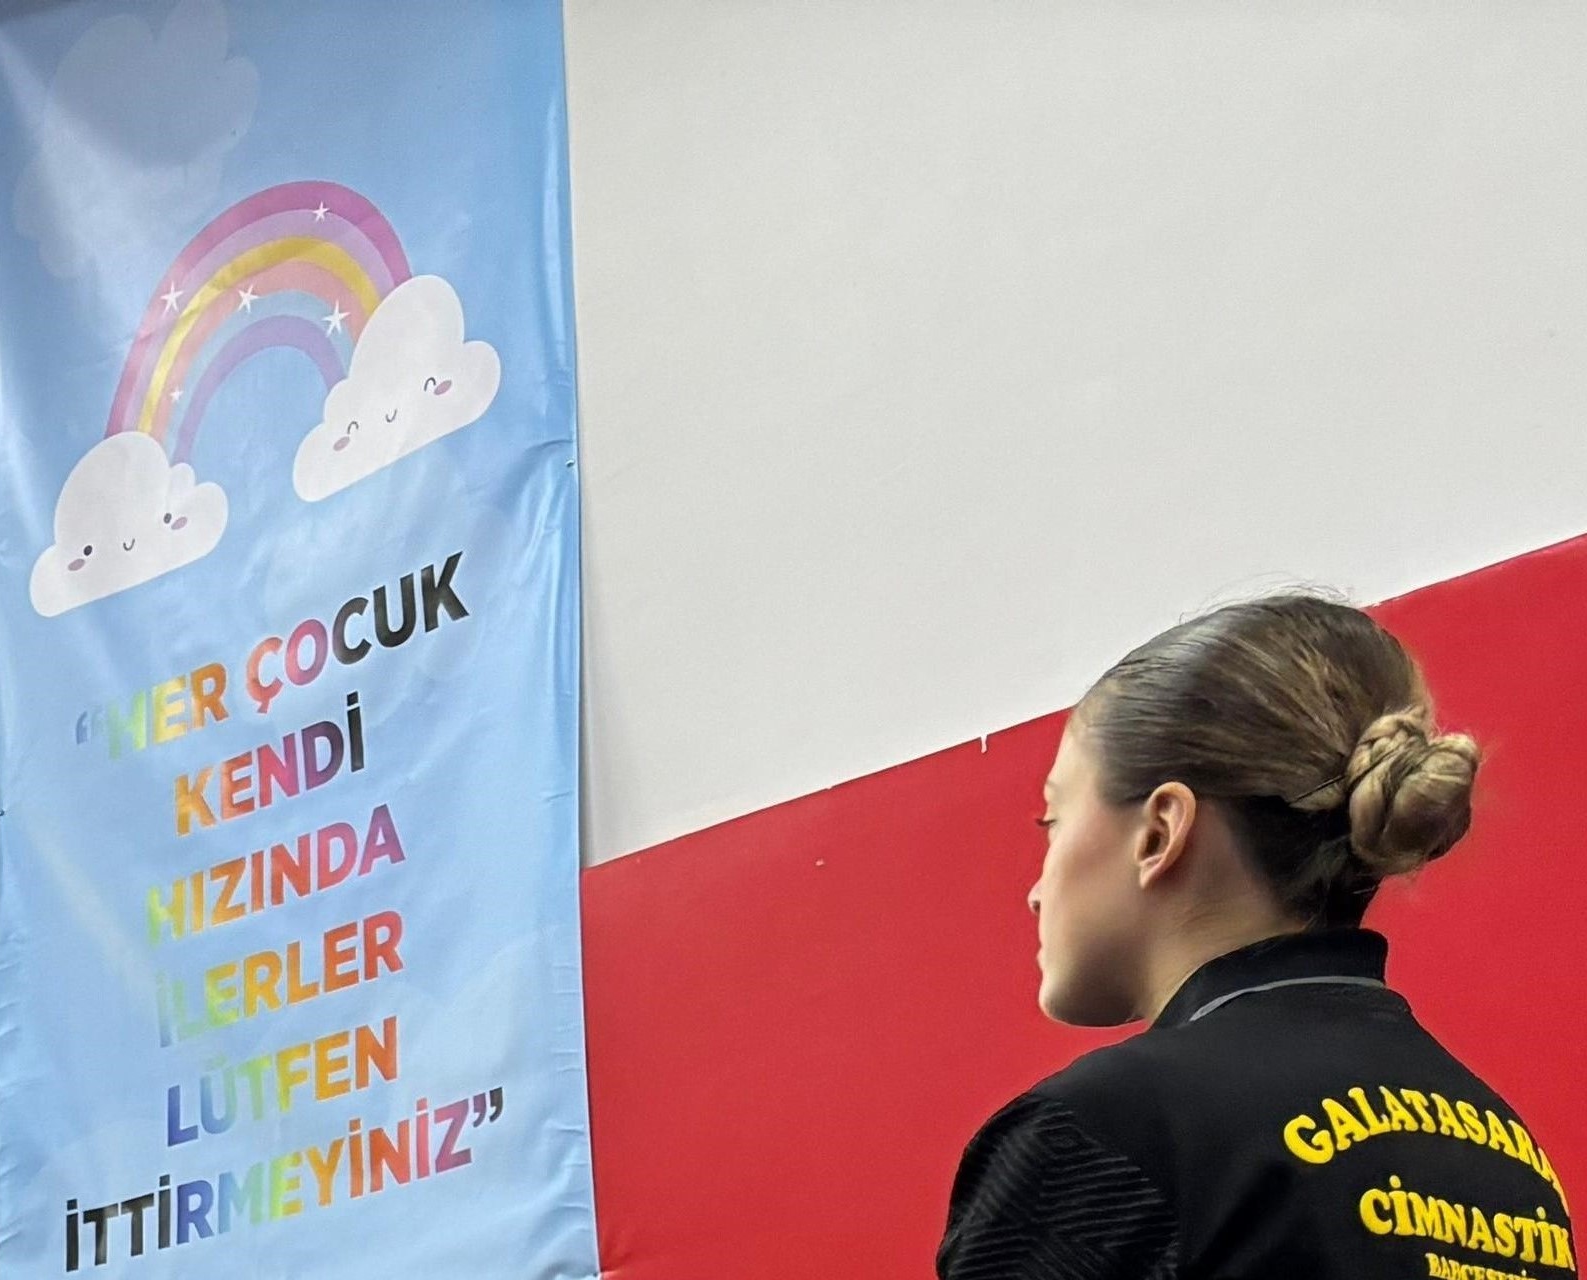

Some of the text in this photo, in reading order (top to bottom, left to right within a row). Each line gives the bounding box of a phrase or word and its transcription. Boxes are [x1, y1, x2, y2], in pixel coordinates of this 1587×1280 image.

[246, 551, 470, 714] ÇOCUK
[175, 691, 365, 837] KENDİ
[147, 803, 407, 945] HIZINDA
[155, 910, 405, 1048] İLERLER
[167, 1015, 398, 1147] LÜTFEN
[1283, 1085, 1570, 1217] GALATASARA
